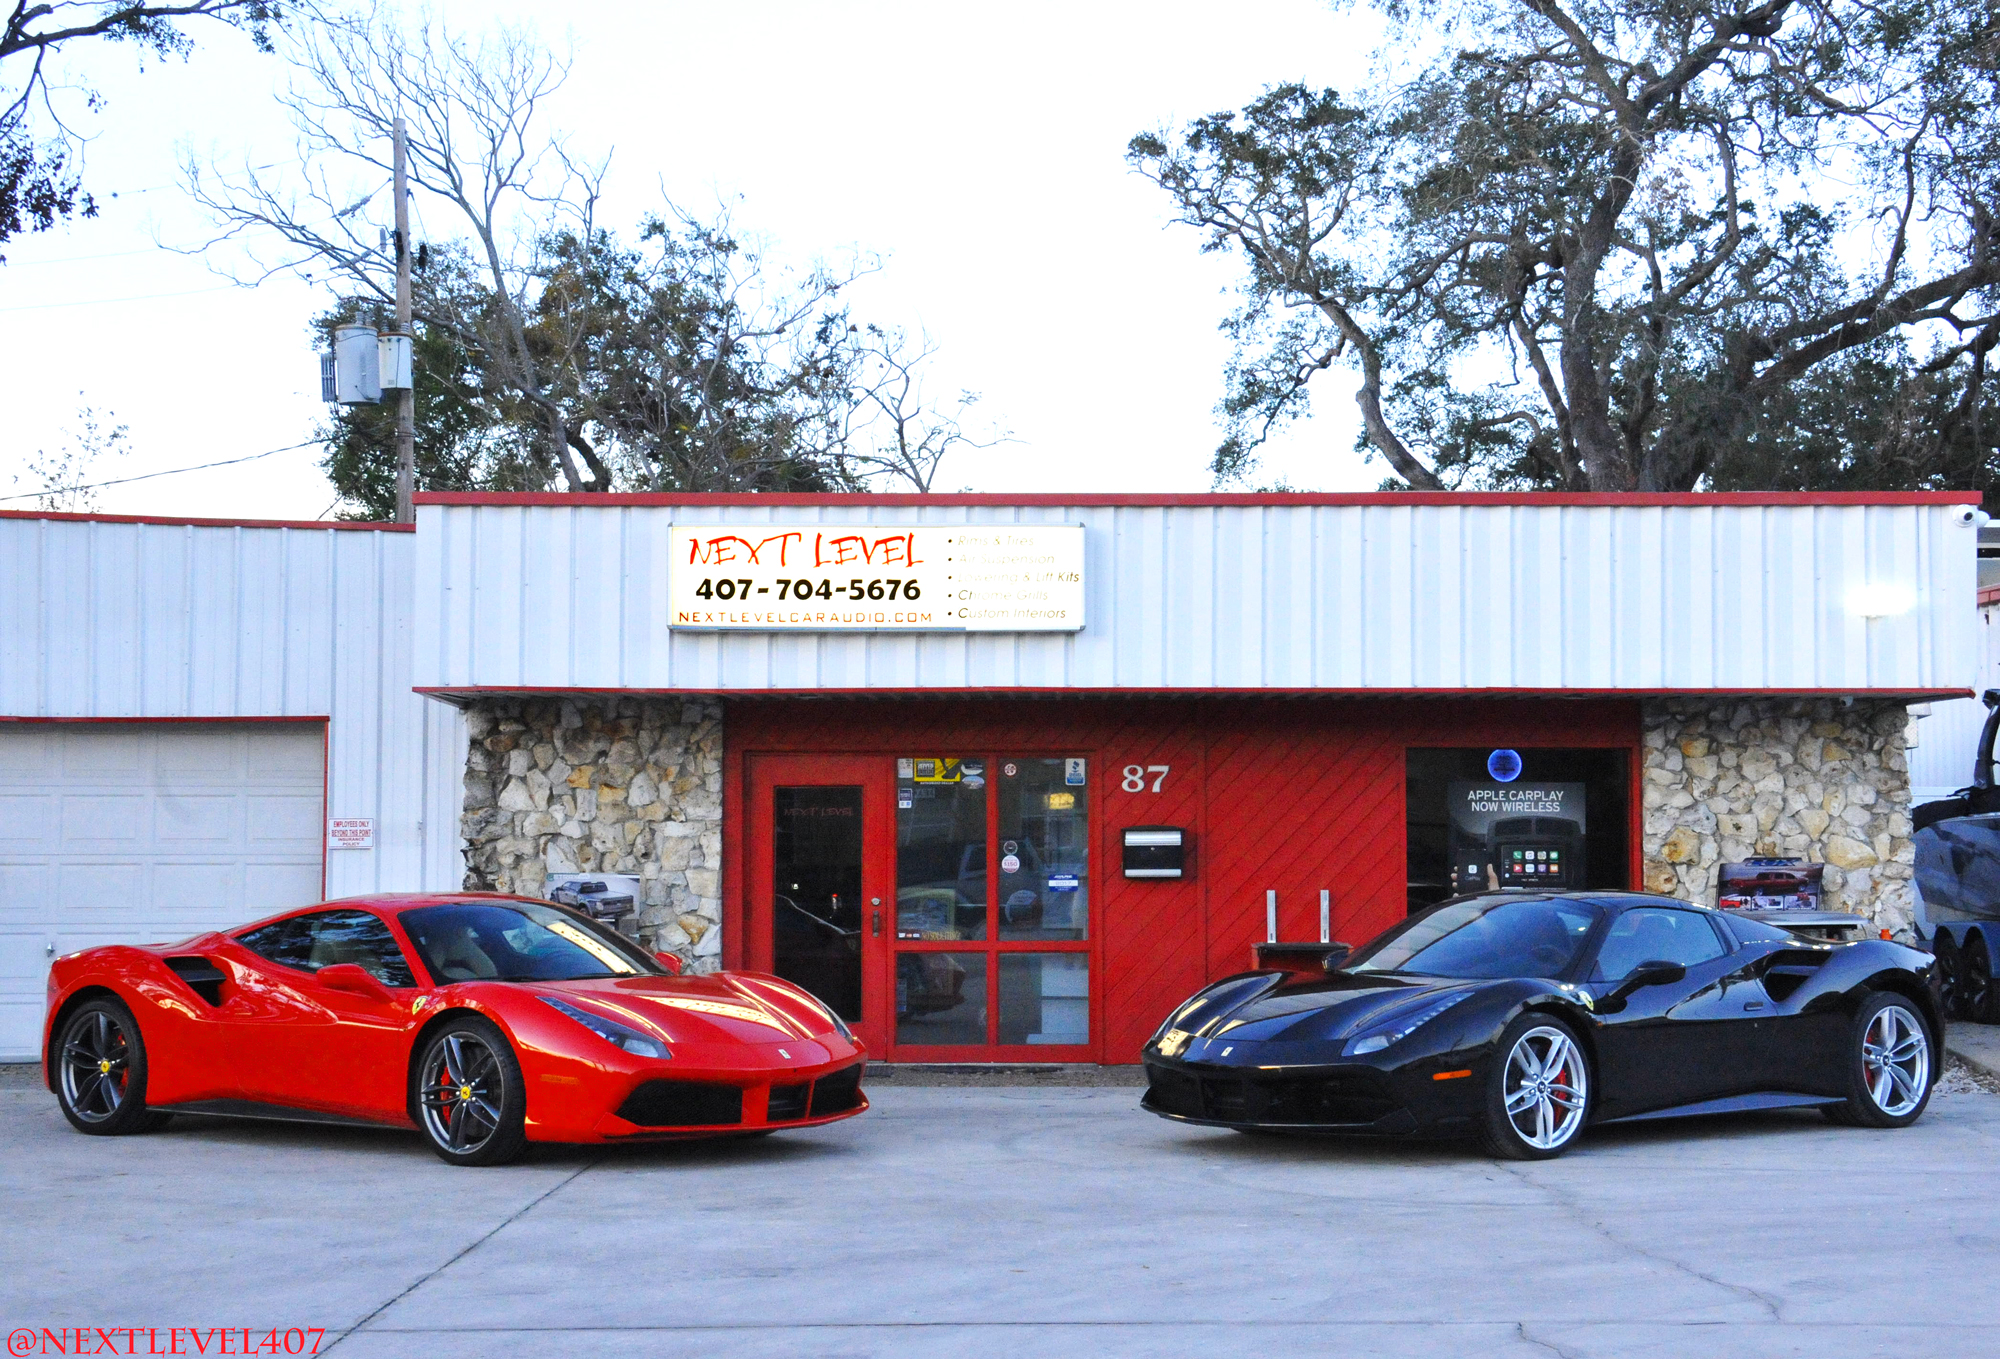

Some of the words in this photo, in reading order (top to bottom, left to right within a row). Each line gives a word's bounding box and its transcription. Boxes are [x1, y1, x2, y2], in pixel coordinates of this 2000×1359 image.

[689, 532, 802, 567] NEXT
[813, 532, 924, 568] LEVEL
[1058, 572, 1080, 582] Kits
[696, 578, 922, 601] 407-704-5676
[679, 611, 933, 624] NEXTLEVELCARAUDIO.COM
[958, 607, 1009, 619] Custom
[1013, 607, 1066, 619] Interiors
[1121, 764, 1170, 793] 87
[1467, 790, 1506, 801] APPLE
[1509, 790, 1564, 801] CARPLAY
[1471, 802, 1499, 812] NOW
[1501, 802, 1561, 812] WIRELESS
[331, 829, 348, 837] BEYOND
[349, 829, 358, 837] THIS
[359, 829, 371, 837] POINT
